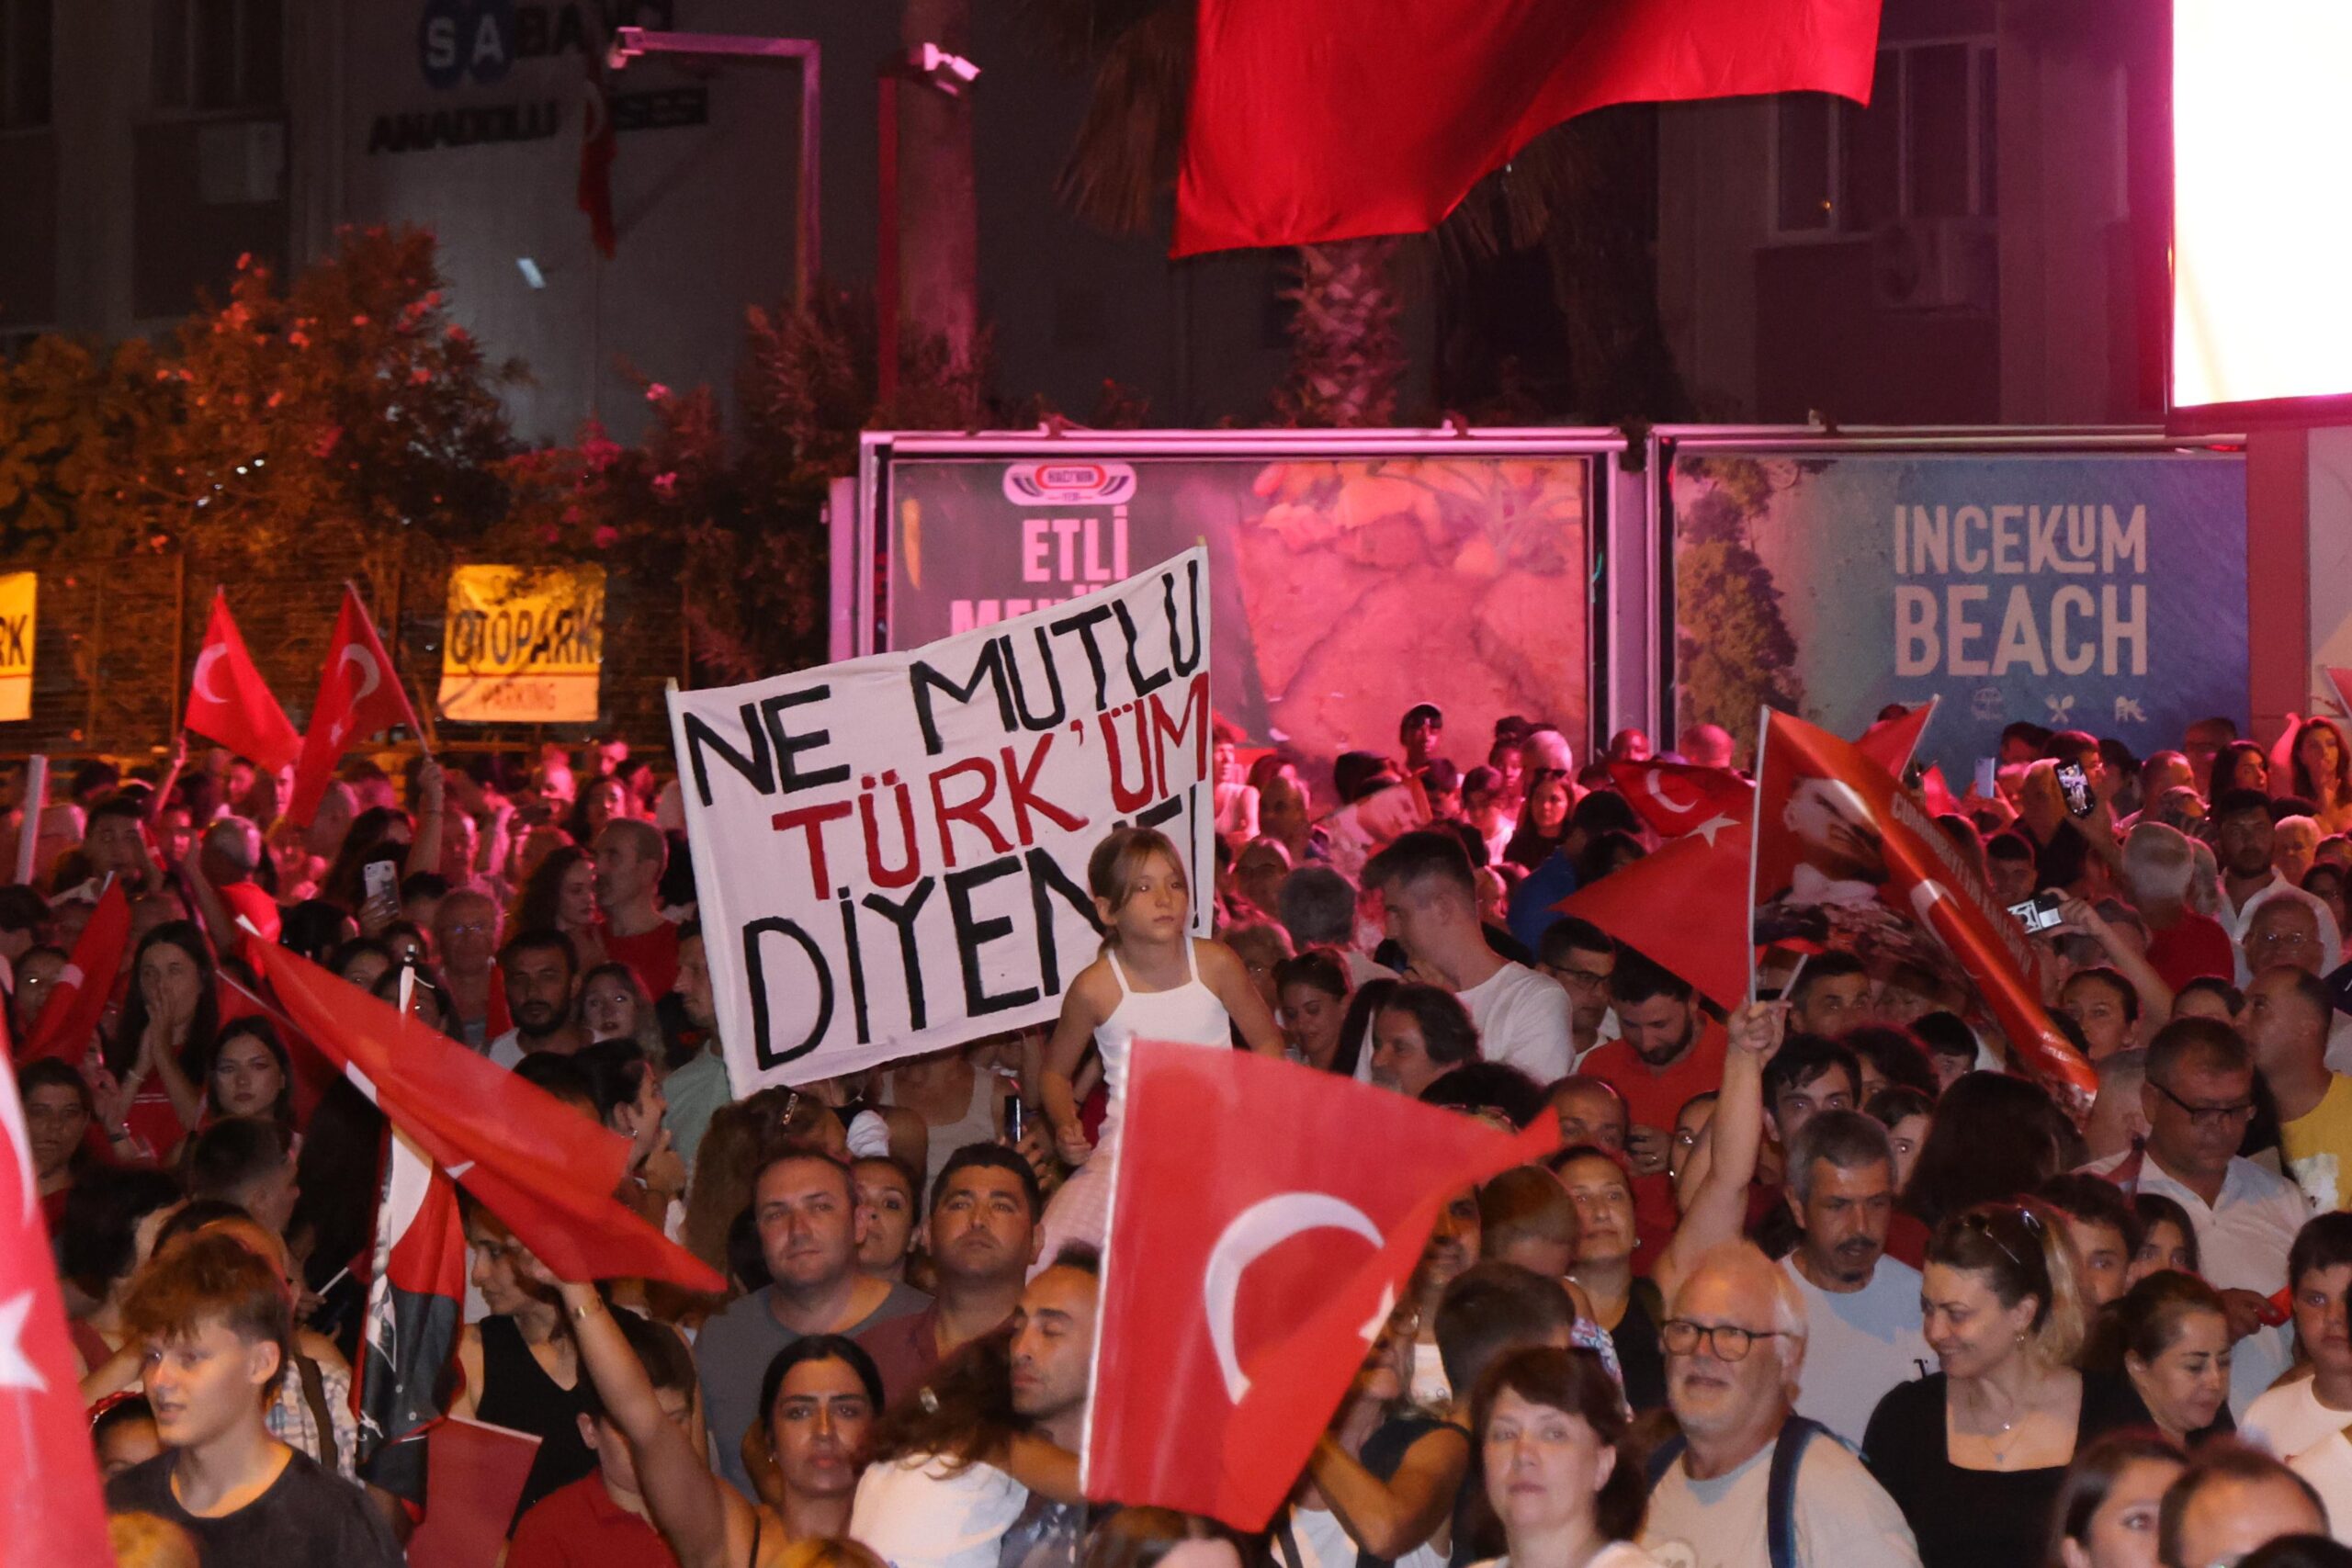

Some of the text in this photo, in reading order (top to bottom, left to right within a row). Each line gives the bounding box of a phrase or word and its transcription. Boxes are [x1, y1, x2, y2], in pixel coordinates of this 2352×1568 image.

[1023, 504, 1128, 582] ETLİ
[1894, 503, 2147, 574] INCEKUM
[451, 607, 597, 665] OTOPARK
[1894, 584, 2148, 676] BEACH
[683, 559, 1202, 807] NE MUTLU
[771, 671, 1210, 901] TÜRK'ÜM
[742, 782, 1200, 1072] DİYEN!
